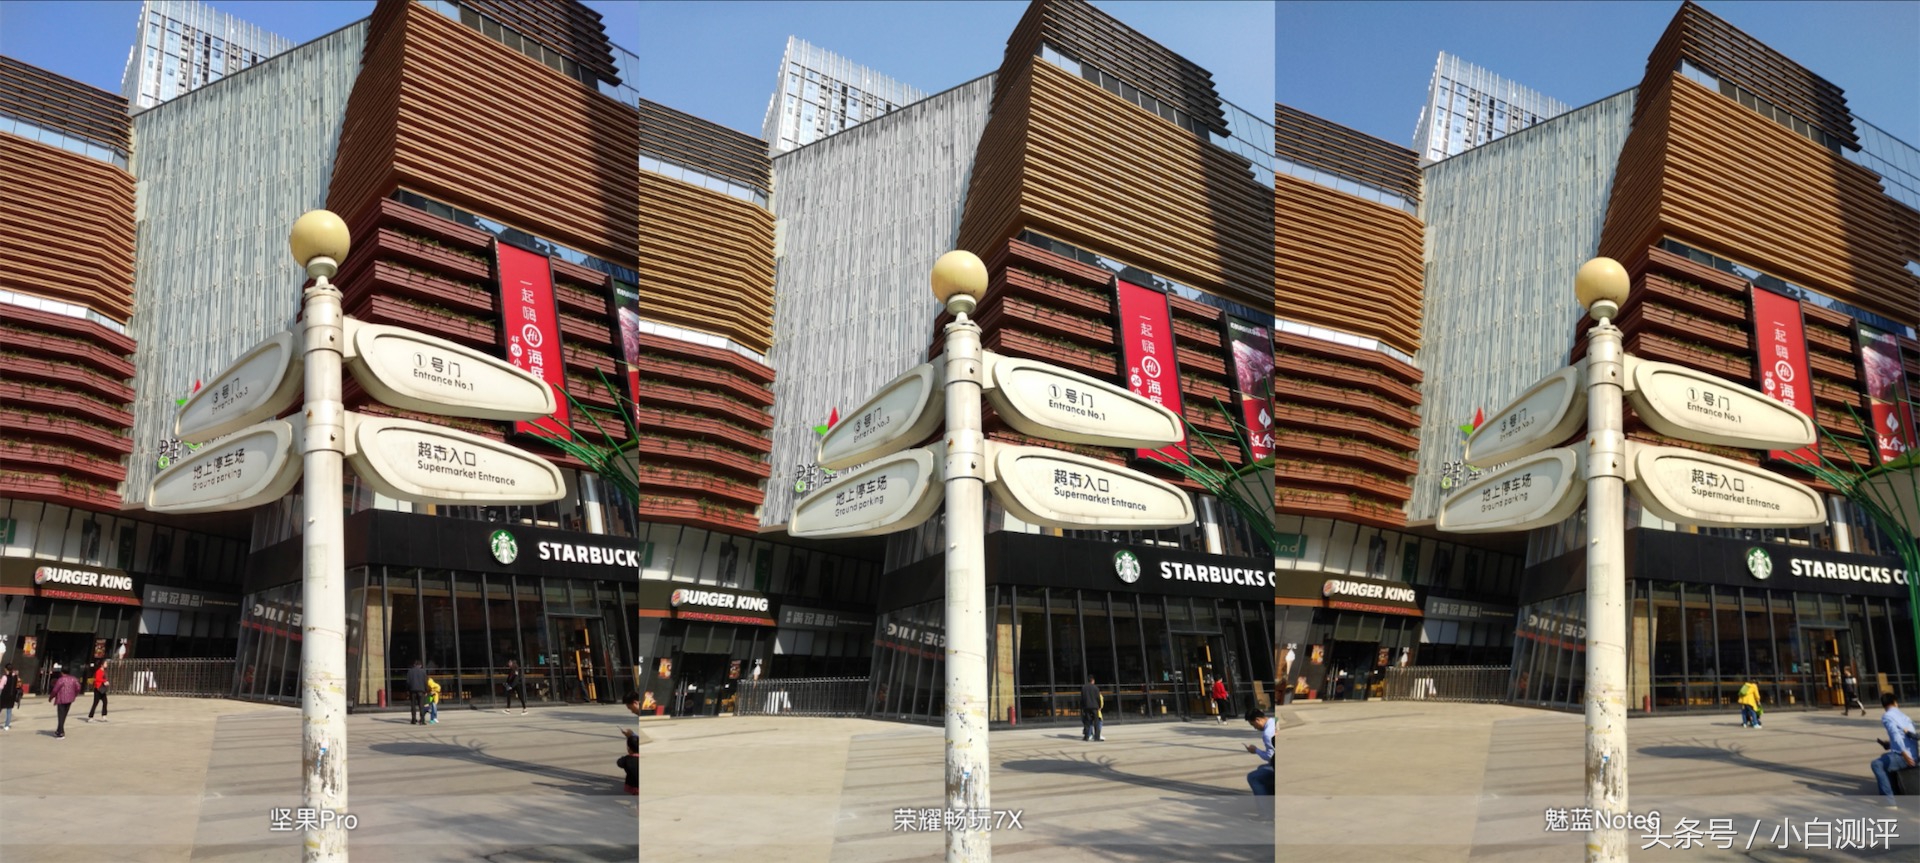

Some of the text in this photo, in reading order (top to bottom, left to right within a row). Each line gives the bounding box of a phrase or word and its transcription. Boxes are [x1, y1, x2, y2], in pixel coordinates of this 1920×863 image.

[413, 368, 474, 391] Entrance No.1
[1048, 399, 1106, 421] Entrance No.1
[1687, 401, 1742, 423] Entrance No.1
[193, 448, 245, 480] 地上停车场
[417, 441, 477, 467] 超市入口
[192, 477, 215, 491] Ground
[417, 460, 516, 486] Supermarket Entrance
[1054, 468, 1110, 493] 超市入口
[1691, 468, 1745, 492] 超市入口
[835, 474, 887, 506] 地上停车场
[1054, 486, 1147, 511] Supermarket Entrance
[1482, 472, 1532, 502] 地上停车场
[1691, 486, 1780, 510] Supermarket Entrance
[835, 495, 884, 517] Ground parking
[1481, 499, 1503, 513] Ground
[538, 541, 639, 568] STARBUCK
[46, 567, 132, 591] BURGER KING
[1160, 561, 1266, 587] STARBUCKS
[1790, 558, 1891, 584] STARBUCKS
[682, 589, 769, 612] BURGER KING
[1334, 580, 1416, 602] BURGER KING
